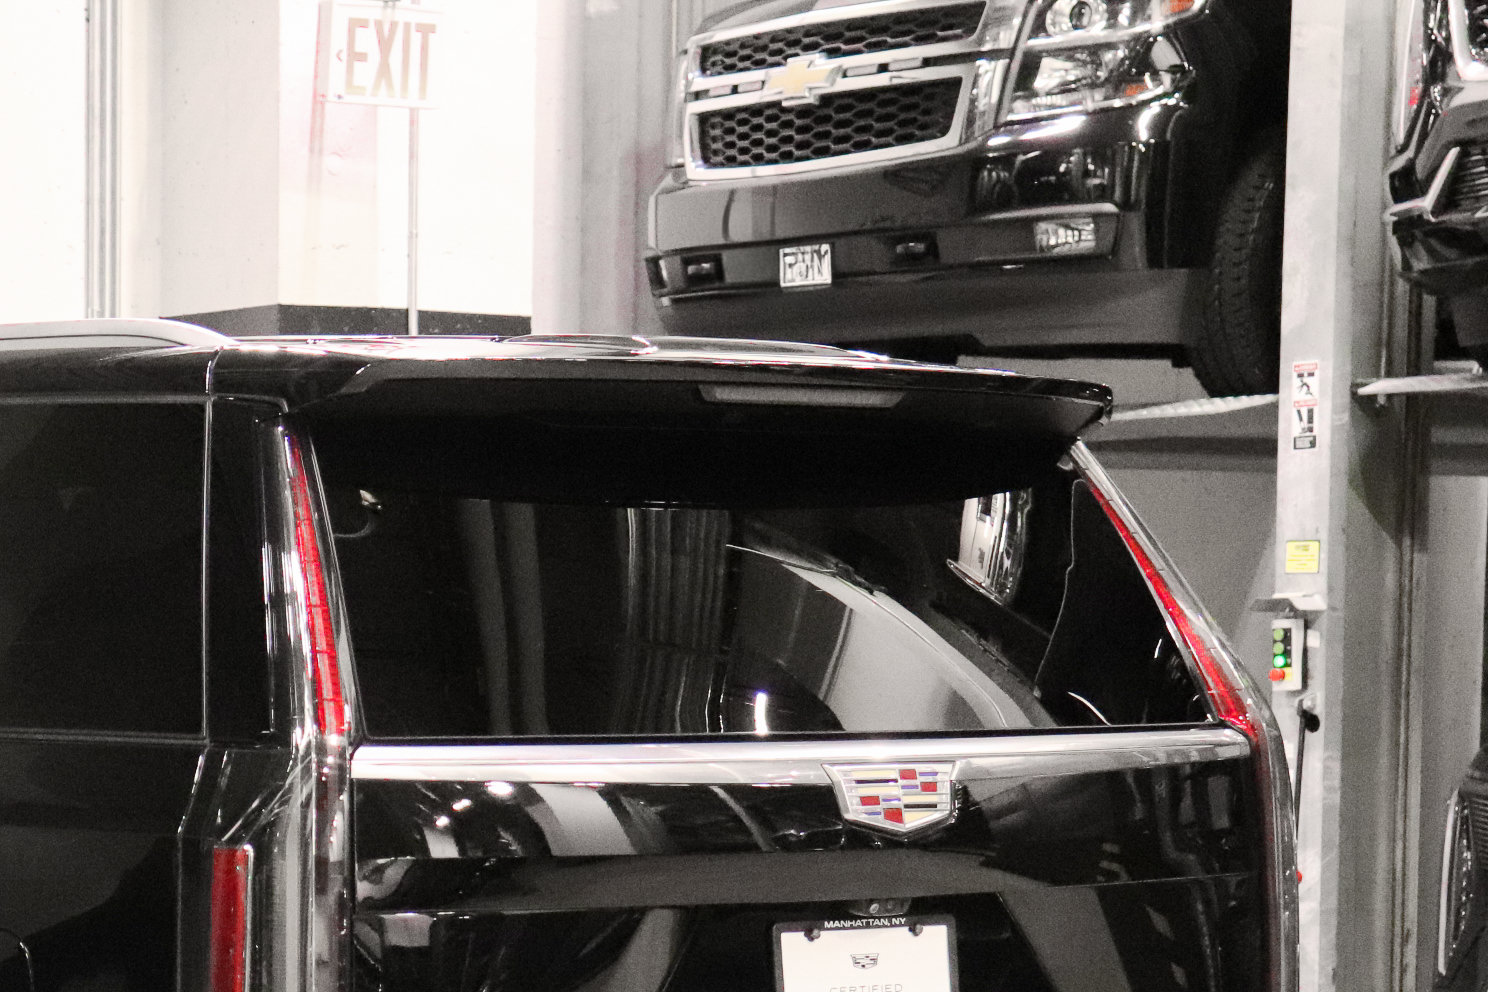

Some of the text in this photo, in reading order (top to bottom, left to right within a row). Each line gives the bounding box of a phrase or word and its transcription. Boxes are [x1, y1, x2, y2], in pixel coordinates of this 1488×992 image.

[345, 18, 436, 100] EXIT
[824, 917, 906, 928] MANHATTAN, NY
